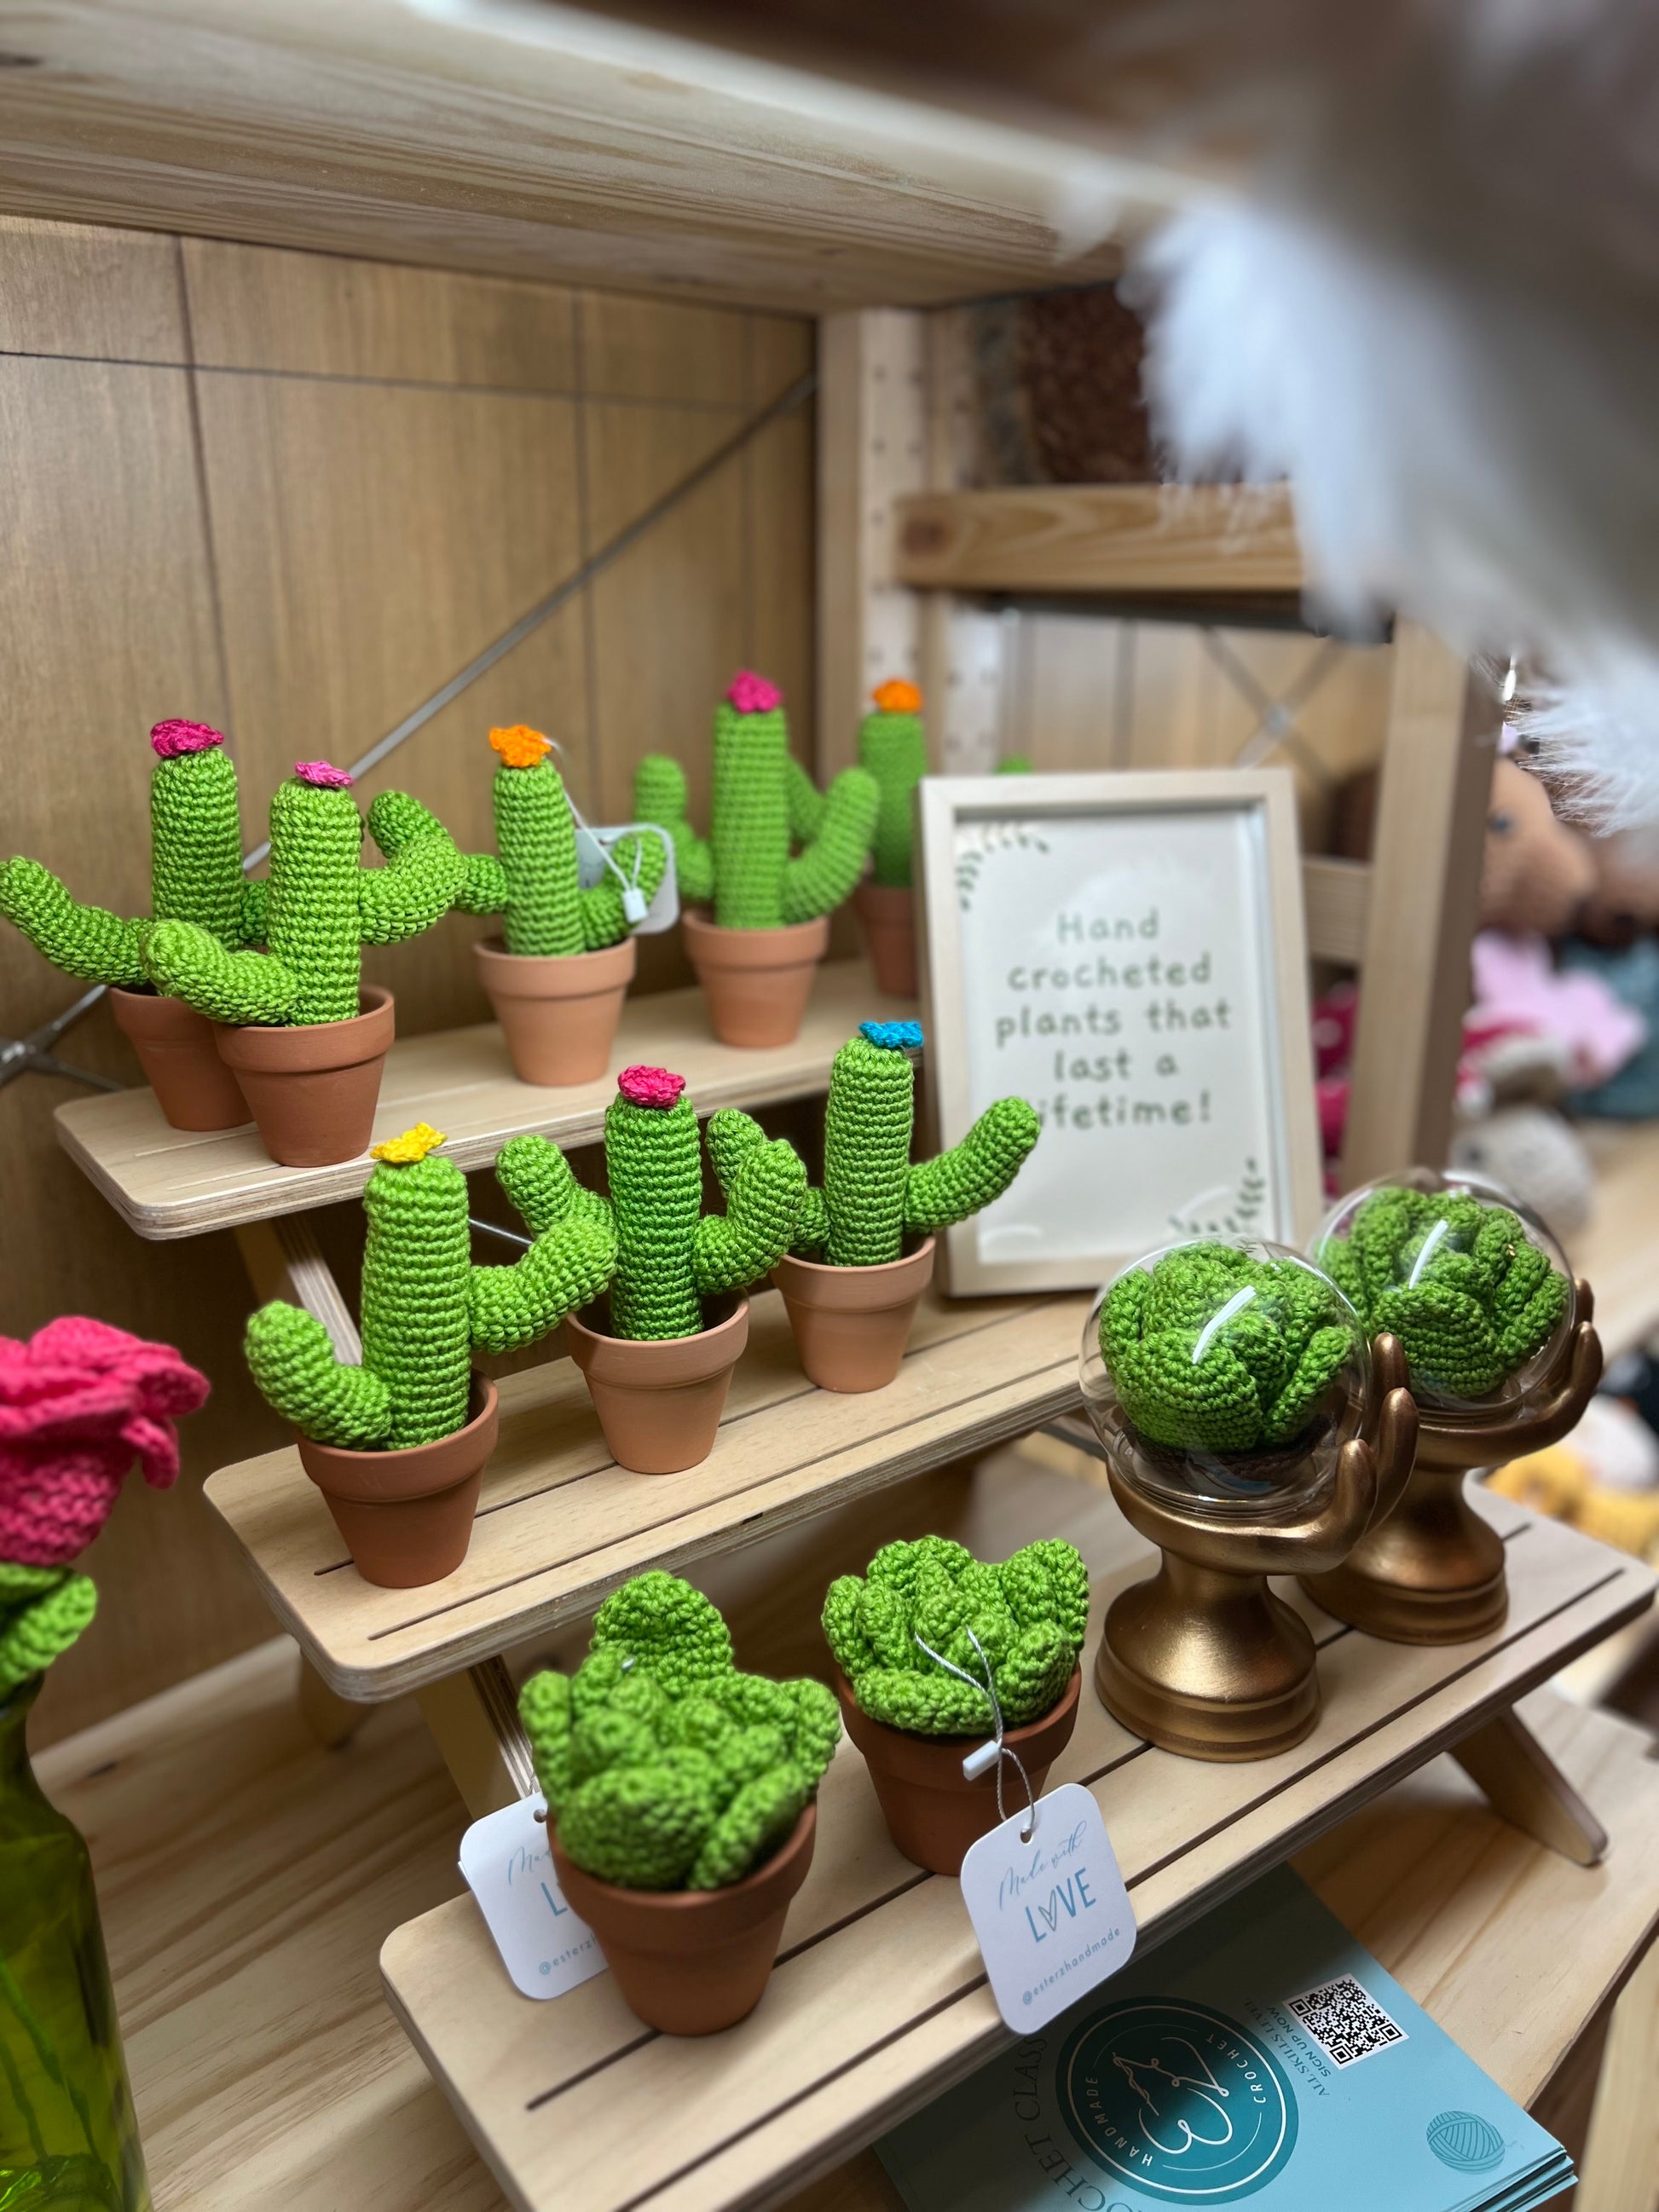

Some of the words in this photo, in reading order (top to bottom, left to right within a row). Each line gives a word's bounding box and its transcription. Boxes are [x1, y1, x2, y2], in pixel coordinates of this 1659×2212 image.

[1056, 909, 1159, 944] Hand
[1008, 952, 1211, 991] crocheted
[995, 1005, 1122, 1048] plants
[1146, 1000, 1231, 1031] that
[1053, 1048, 1133, 1082] last
[1155, 1054, 1178, 1077] a
[1038, 1089, 1212, 1130] ifetime!
[1022, 1926, 1121, 2005] @esterzhandmade
[1265, 2005, 1295, 2034] NOW
[1270, 2033, 1310, 2075] SKILLS
[1291, 2034, 1309, 2051] UP
[1205, 2033, 1267, 2105] CROCHET
[1304, 2050, 1332, 2078] SIGN
[1305, 2072, 1332, 2097] ALL
[1085, 2076, 1153, 2168] HANDMADE
